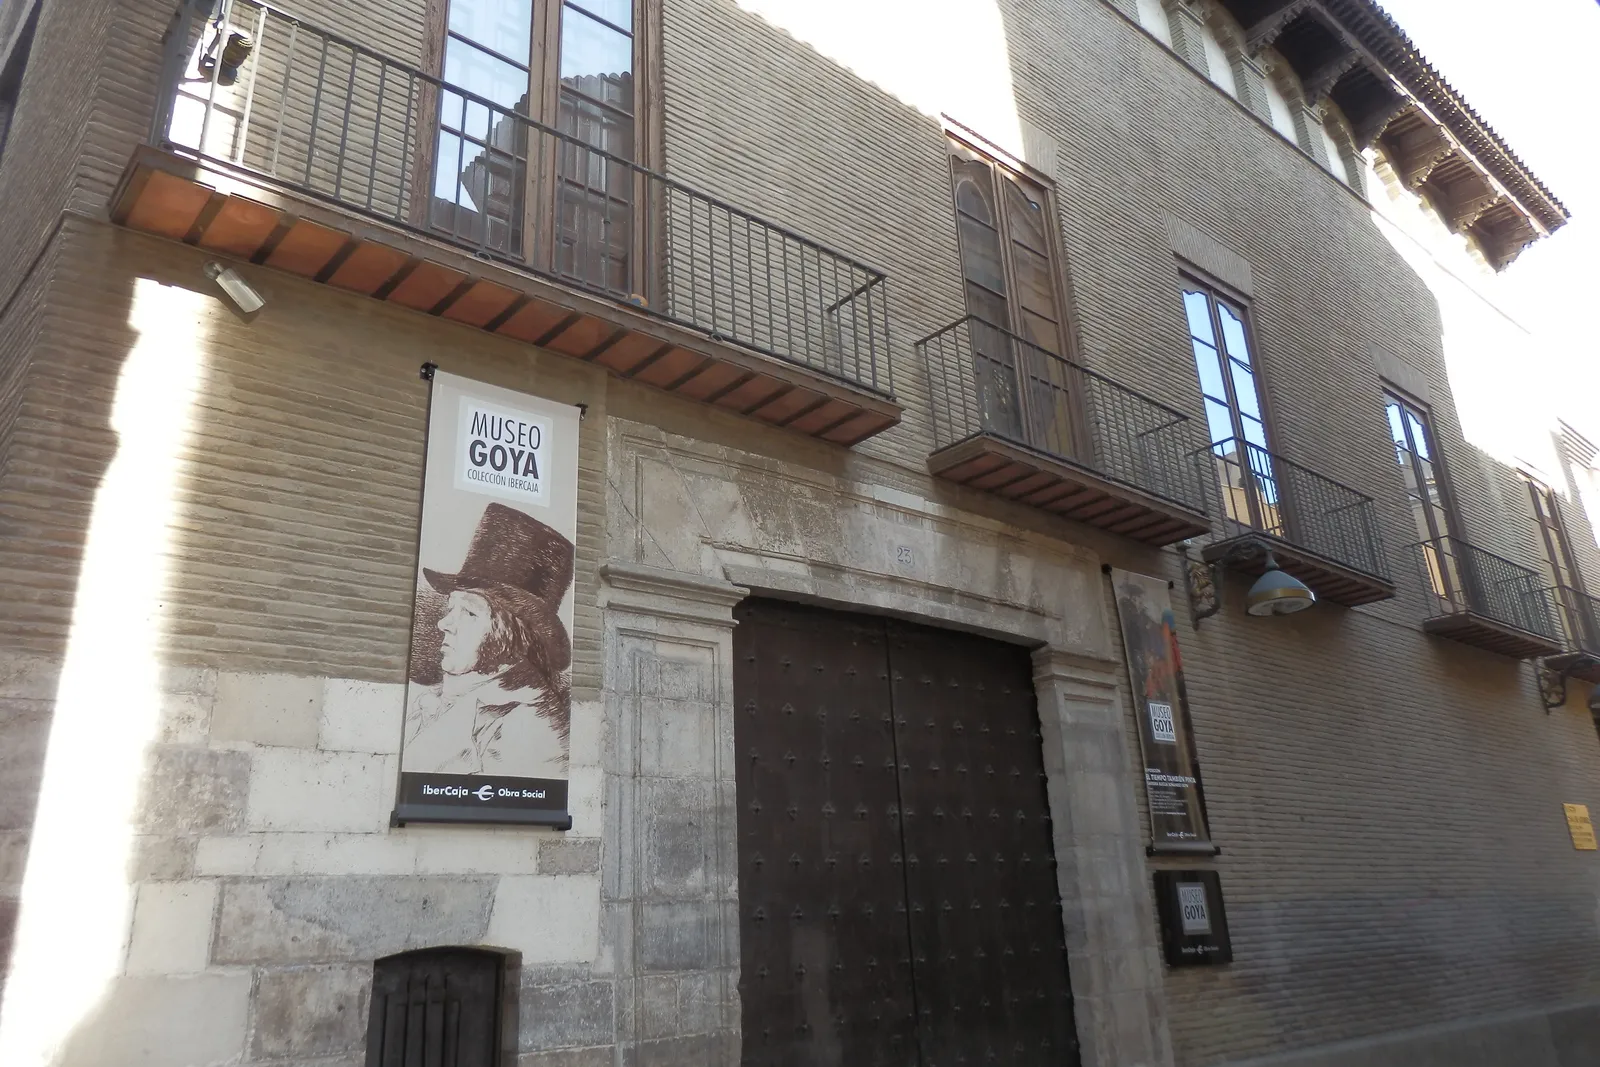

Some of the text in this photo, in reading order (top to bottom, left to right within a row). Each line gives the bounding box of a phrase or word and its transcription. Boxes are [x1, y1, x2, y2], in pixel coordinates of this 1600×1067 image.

[470, 411, 541, 450] MUSEO
[469, 439, 539, 480] GOYA
[467, 468, 539, 493] COLECCIÓN IBERCAJA
[897, 547, 912, 564] 23
[1150, 704, 1172, 719] MUSEO
[1153, 718, 1174, 733] GOYA
[498, 788, 520, 797] Obra
[522, 789, 546, 799] Social
[1180, 888, 1204, 904] MUSEO
[1184, 905, 1206, 920] GOYA
